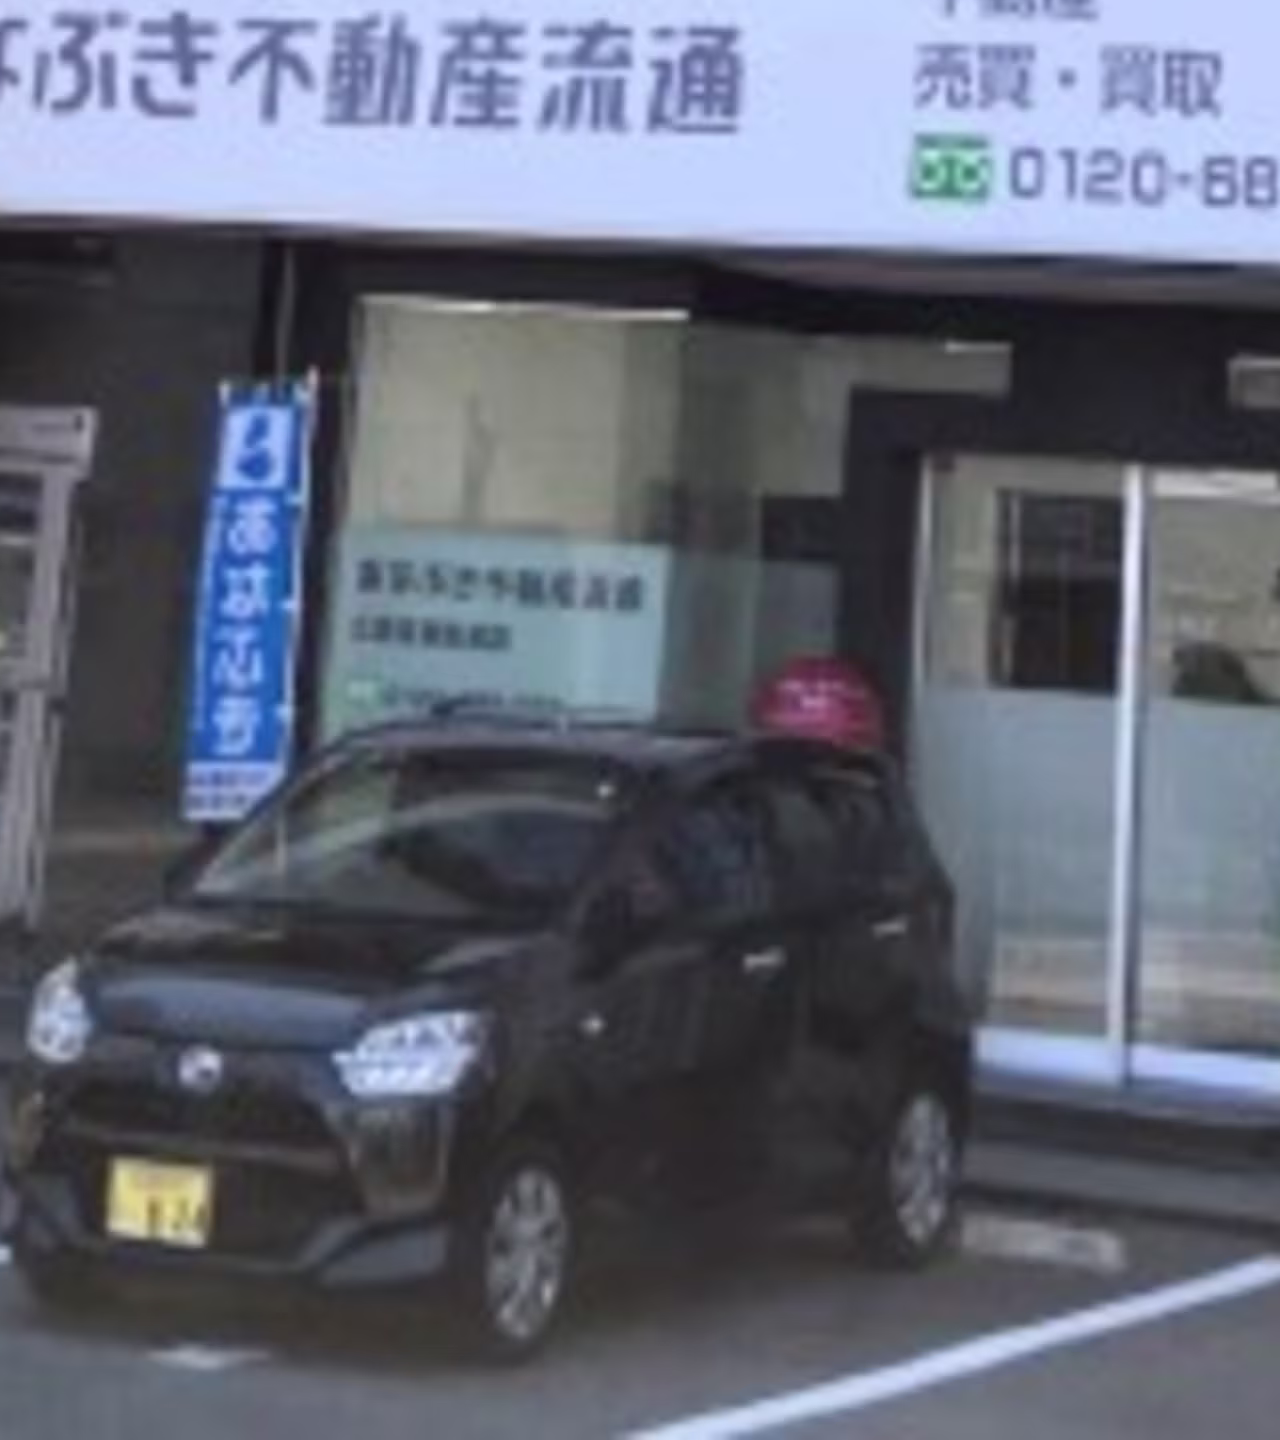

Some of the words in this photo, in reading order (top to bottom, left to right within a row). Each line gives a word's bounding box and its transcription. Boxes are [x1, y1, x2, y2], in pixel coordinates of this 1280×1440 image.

[913, 43, 1224, 117] 売買・買取
